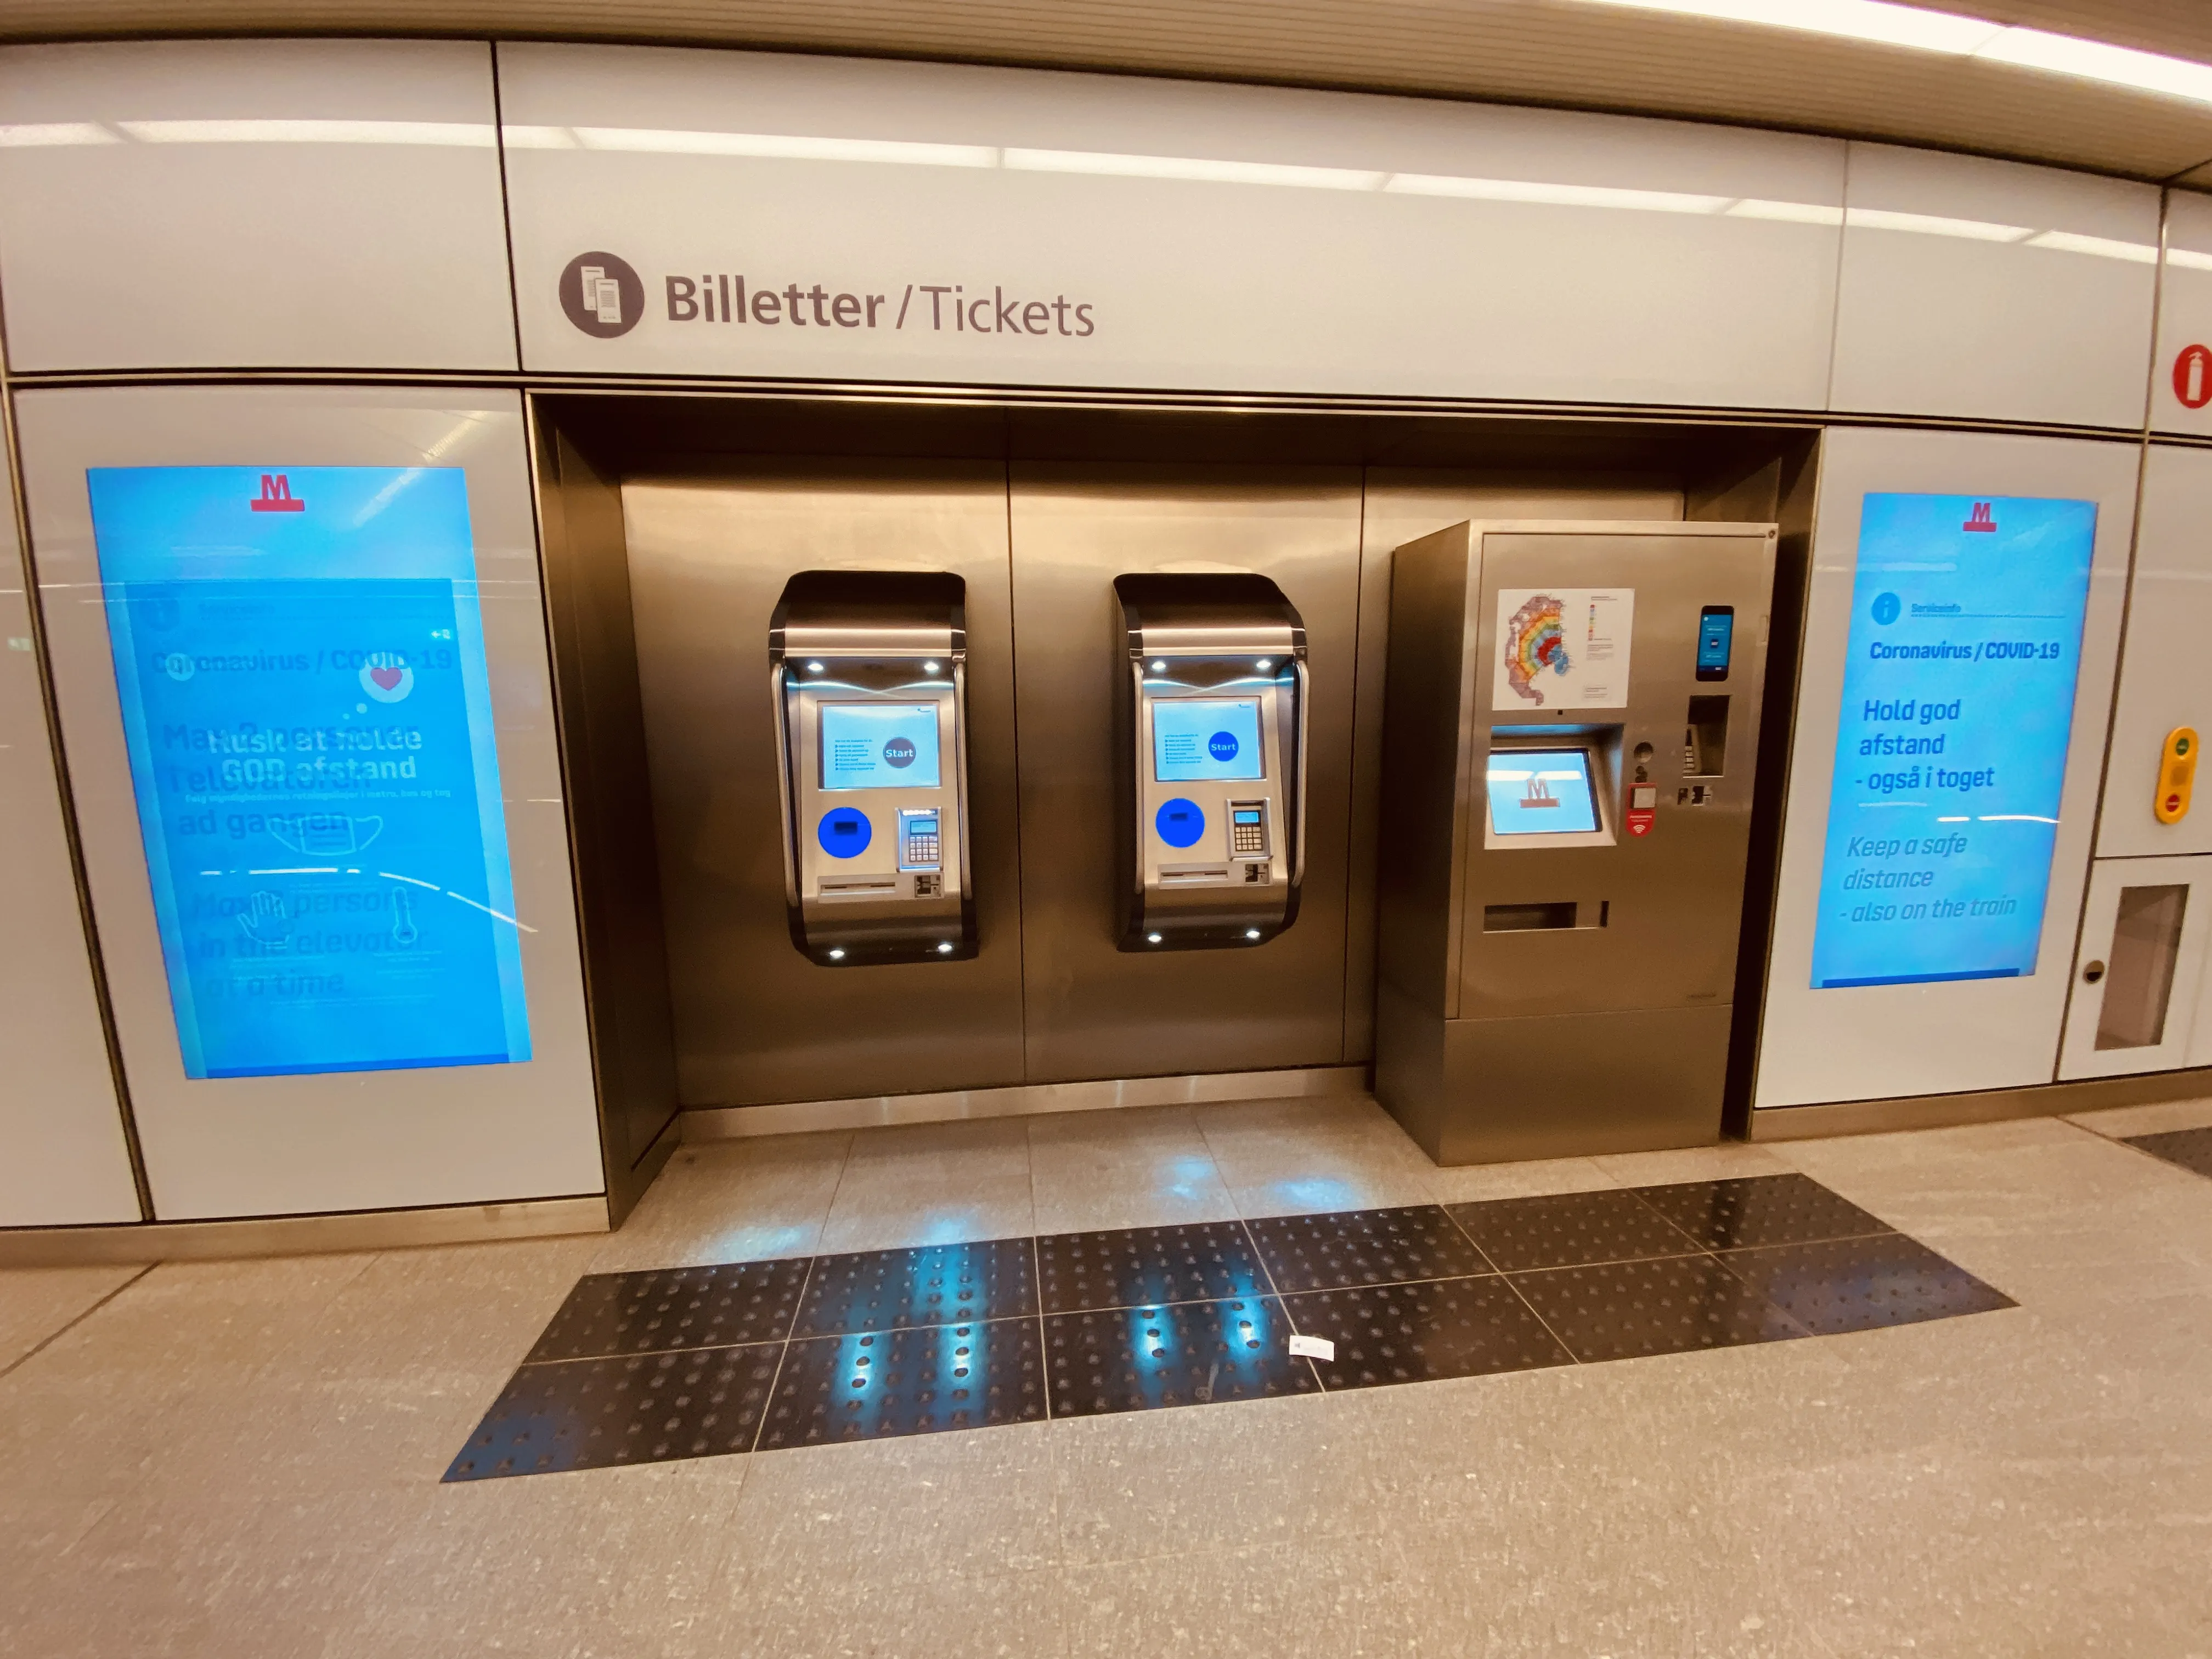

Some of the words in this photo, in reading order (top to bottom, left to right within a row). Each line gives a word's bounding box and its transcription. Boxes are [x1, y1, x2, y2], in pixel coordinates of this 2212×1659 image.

[665, 274, 885, 329] Billetter
[261, 474, 292, 500] M
[1971, 503, 1991, 523] M
[331, 648, 452, 671] COVID-19
[1870, 640, 1972, 659] Coronavirus
[1985, 642, 2061, 659] COVID-19
[1863, 699, 1916, 721] Hold
[1920, 698, 1961, 725] god
[207, 729, 286, 754] Husk
[295, 730, 328, 751] at
[885, 749, 914, 758] Start
[1859, 733, 1945, 756] afstand
[222, 758, 286, 783] GOD
[296, 756, 417, 781] afstand
[1868, 766, 1920, 793] også
[1925, 766, 1933, 788] i
[1937, 767, 1995, 792] toget
[178, 809, 218, 836] ad
[226, 811, 348, 840] gangen
[1847, 836, 1900, 860] Keep
[1904, 838, 1918, 854] a
[1921, 832, 1968, 857] safe
[1843, 867, 1934, 890] distance
[1851, 901, 1897, 922] also
[1900, 902, 1927, 920] on
[1932, 898, 1966, 918] the
[1970, 894, 2017, 916] train
